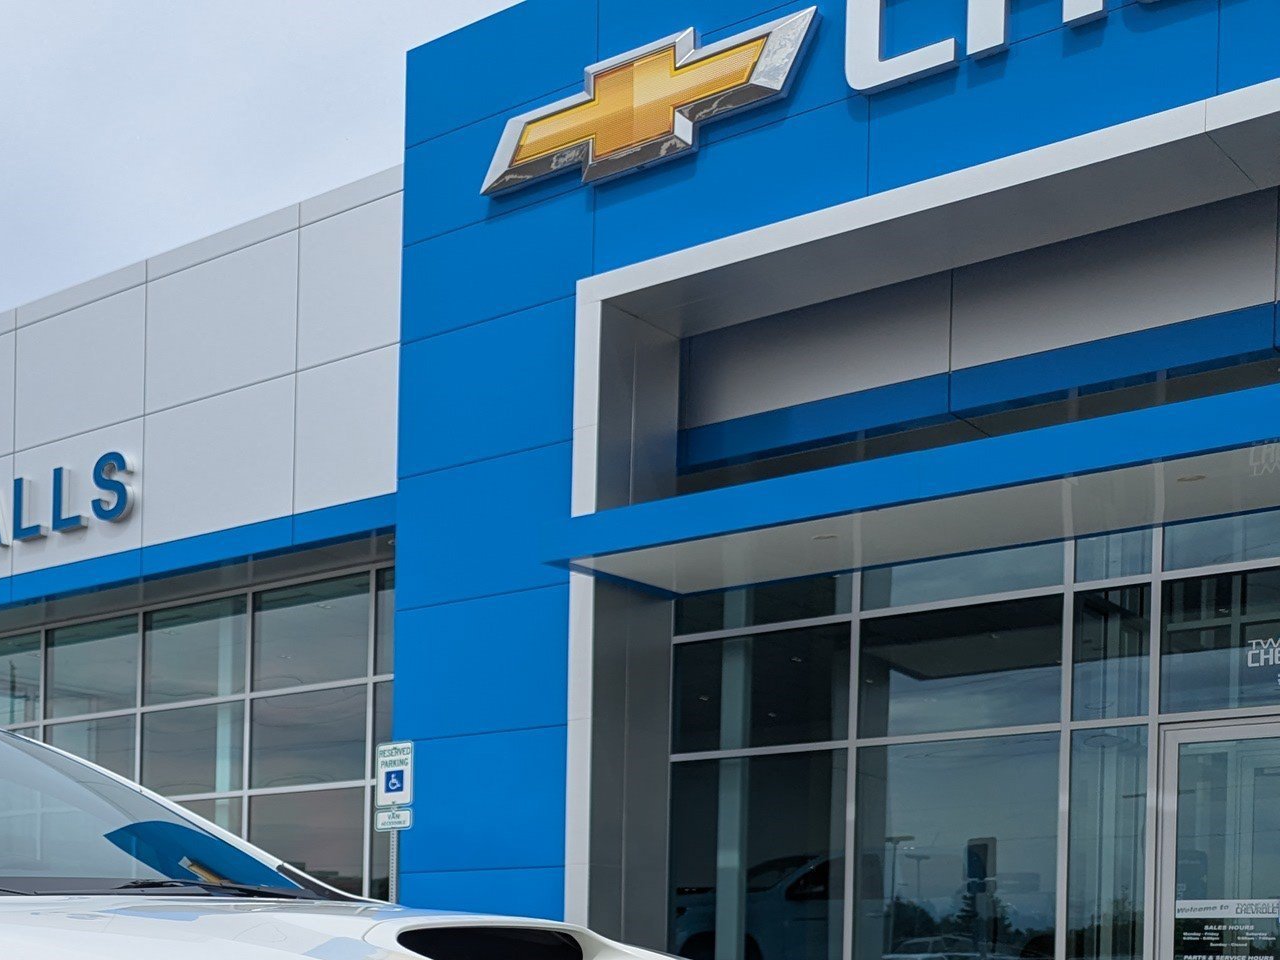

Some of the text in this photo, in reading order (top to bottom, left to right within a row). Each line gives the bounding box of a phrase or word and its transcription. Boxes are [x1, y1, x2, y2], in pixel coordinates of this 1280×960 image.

[380, 747, 410, 758] RESERVED
[381, 758, 408, 769] PARKING
[387, 812, 401, 820] VAN
[1177, 905, 1217, 914] Welcome
